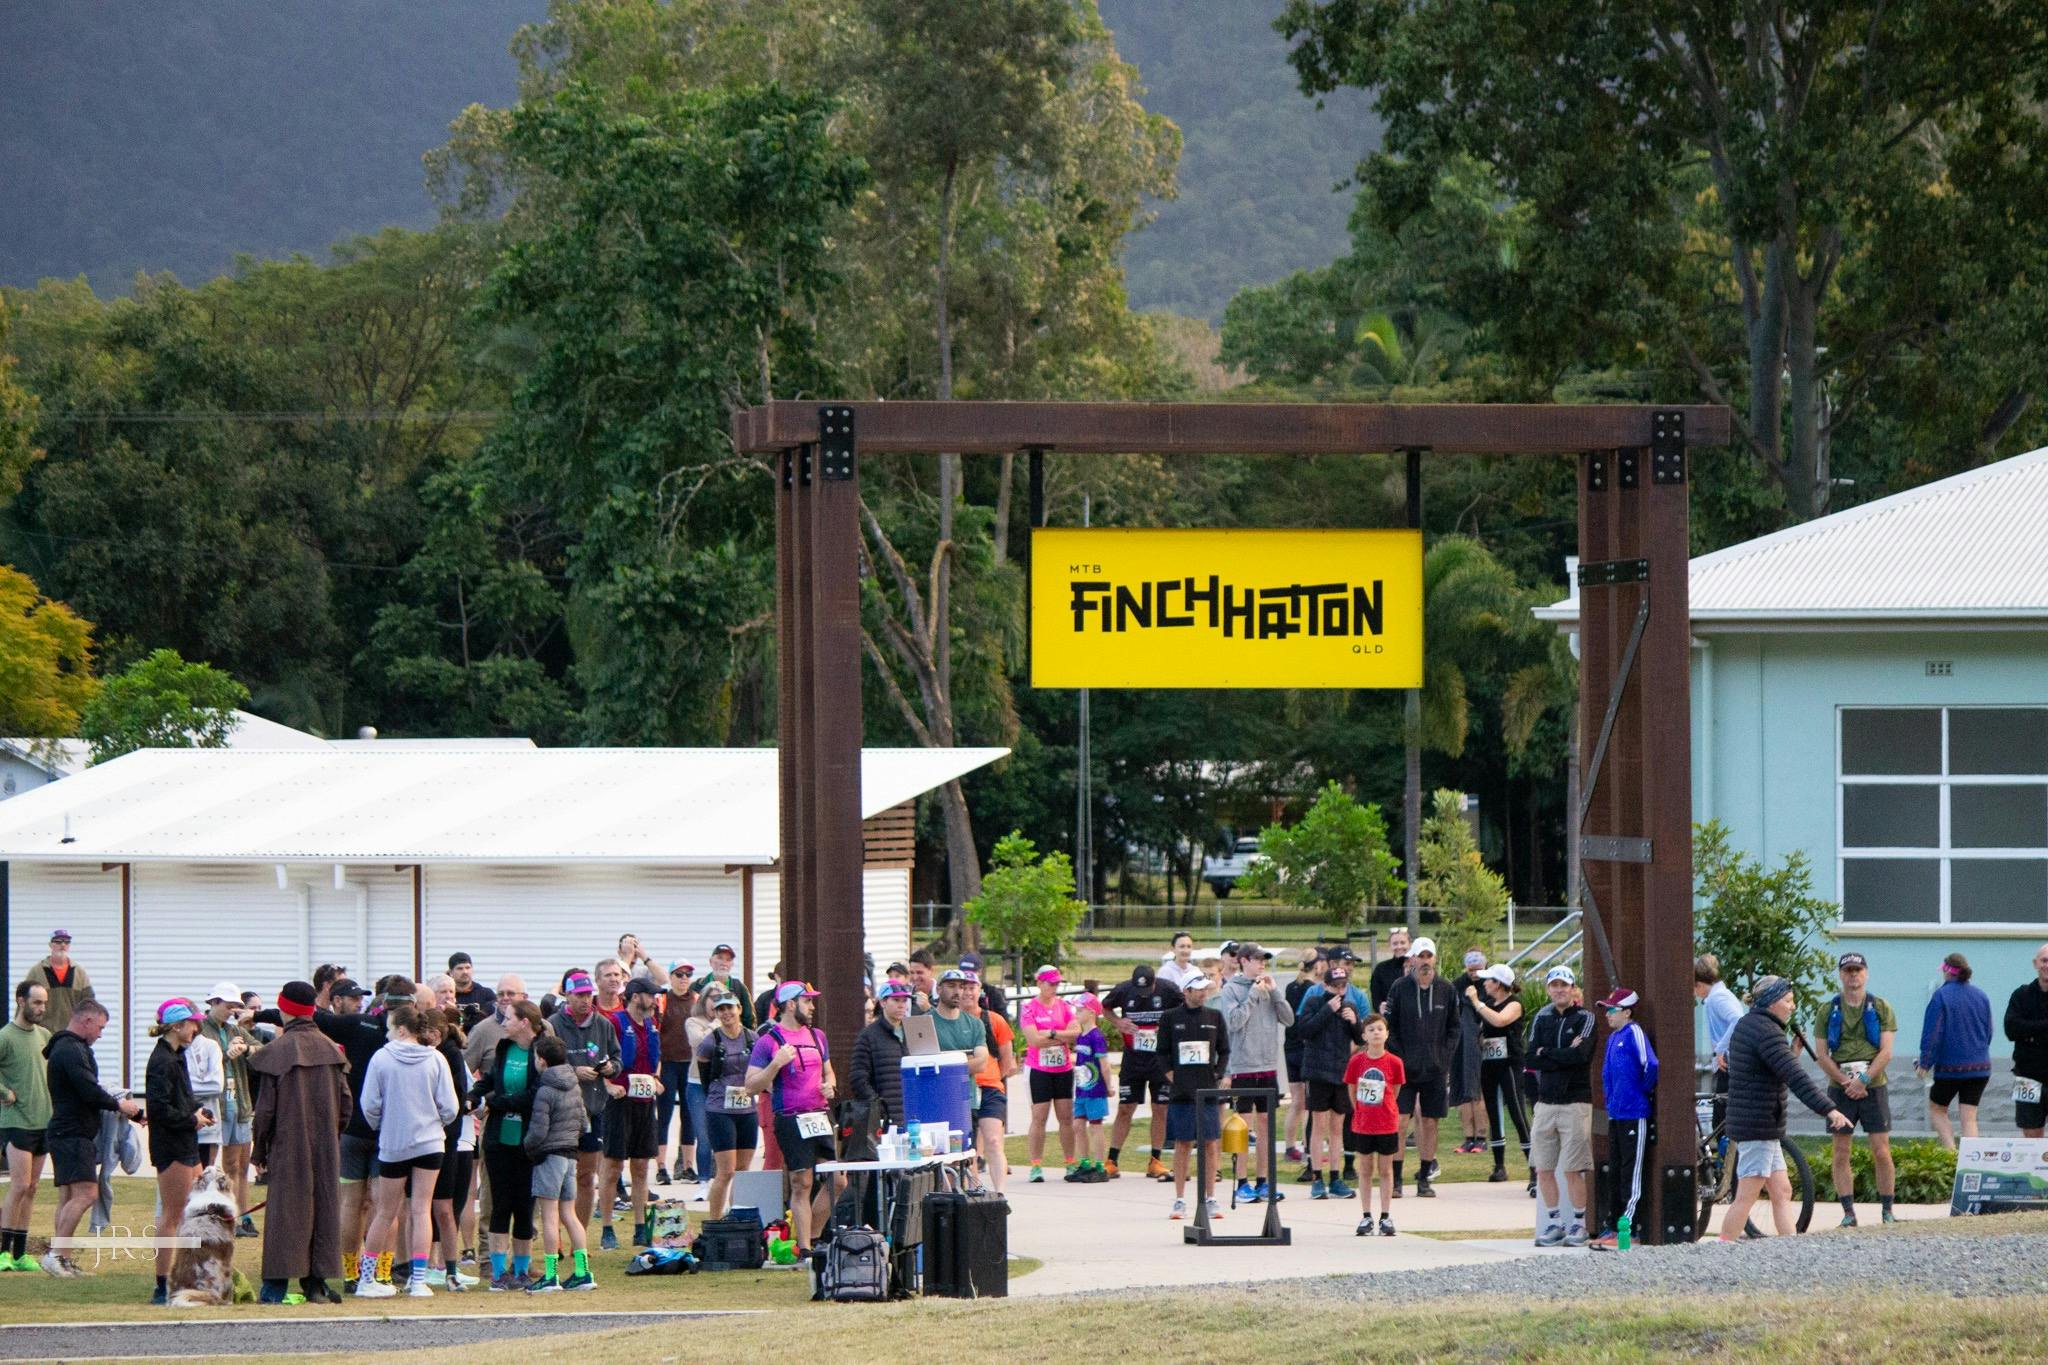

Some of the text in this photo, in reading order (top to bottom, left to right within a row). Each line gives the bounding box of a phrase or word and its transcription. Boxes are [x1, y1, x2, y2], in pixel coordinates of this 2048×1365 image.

[1069, 564, 1102, 575] MTB
[1352, 644, 1384, 655] QLD
[1139, 1038, 1156, 1050] 147
[1045, 1054, 1063, 1065] 146
[1189, 1050, 1201, 1062] 21
[634, 1084, 652, 1096] 138
[1360, 1088, 1377, 1102] 175
[2017, 1087, 2035, 1100] 186
[805, 1121, 827, 1135] 184
